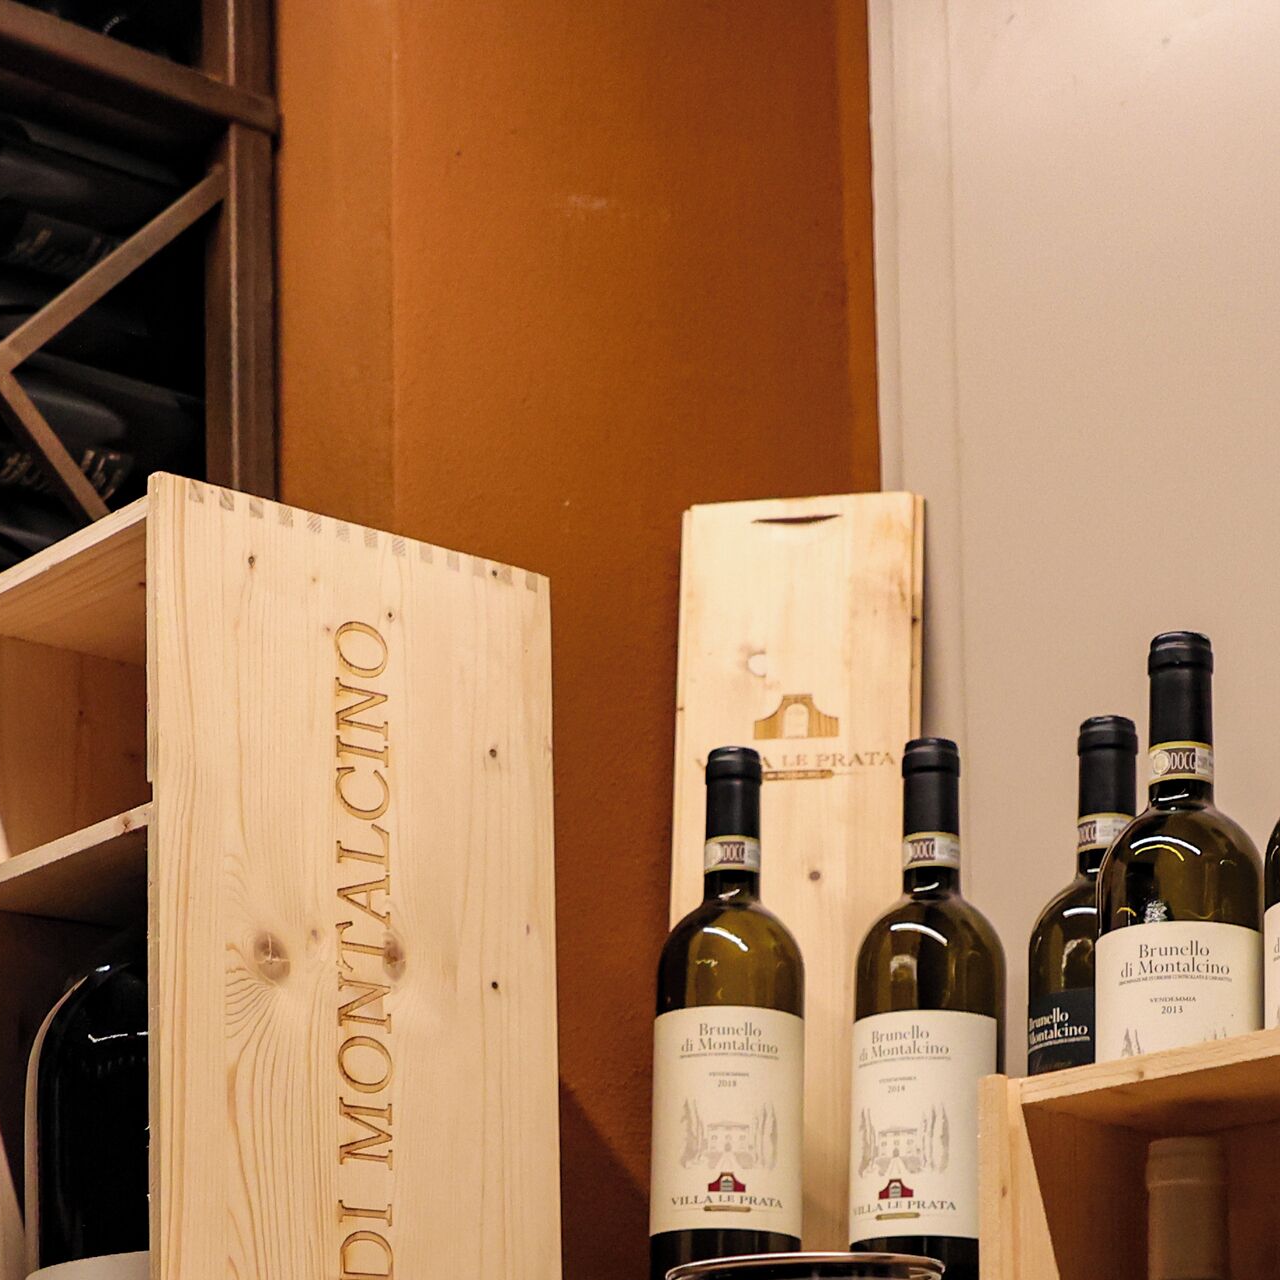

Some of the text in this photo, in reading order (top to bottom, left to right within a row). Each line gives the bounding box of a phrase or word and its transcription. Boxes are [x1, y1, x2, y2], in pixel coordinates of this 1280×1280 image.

[782, 753, 808, 768] LE
[815, 751, 897, 768] PRATA
[334, 620, 393, 1171] MONTALCINO
[1139, 940, 1210, 959] Brunello
[1120, 957, 1231, 979] di Montalcino
[1161, 1005, 1184, 1015] 2013
[698, 1022, 762, 1038] Brunello
[871, 1024, 930, 1044] Brunello
[681, 1037, 779, 1054] di Montalcino
[858, 1046, 869, 1062] di
[870, 1041, 950, 1060] Montalcino
[671, 1193, 784, 1209] VILLA LE PRATA
[887, 1200, 903, 1210] LE
[907, 1200, 957, 1211] PRATA
